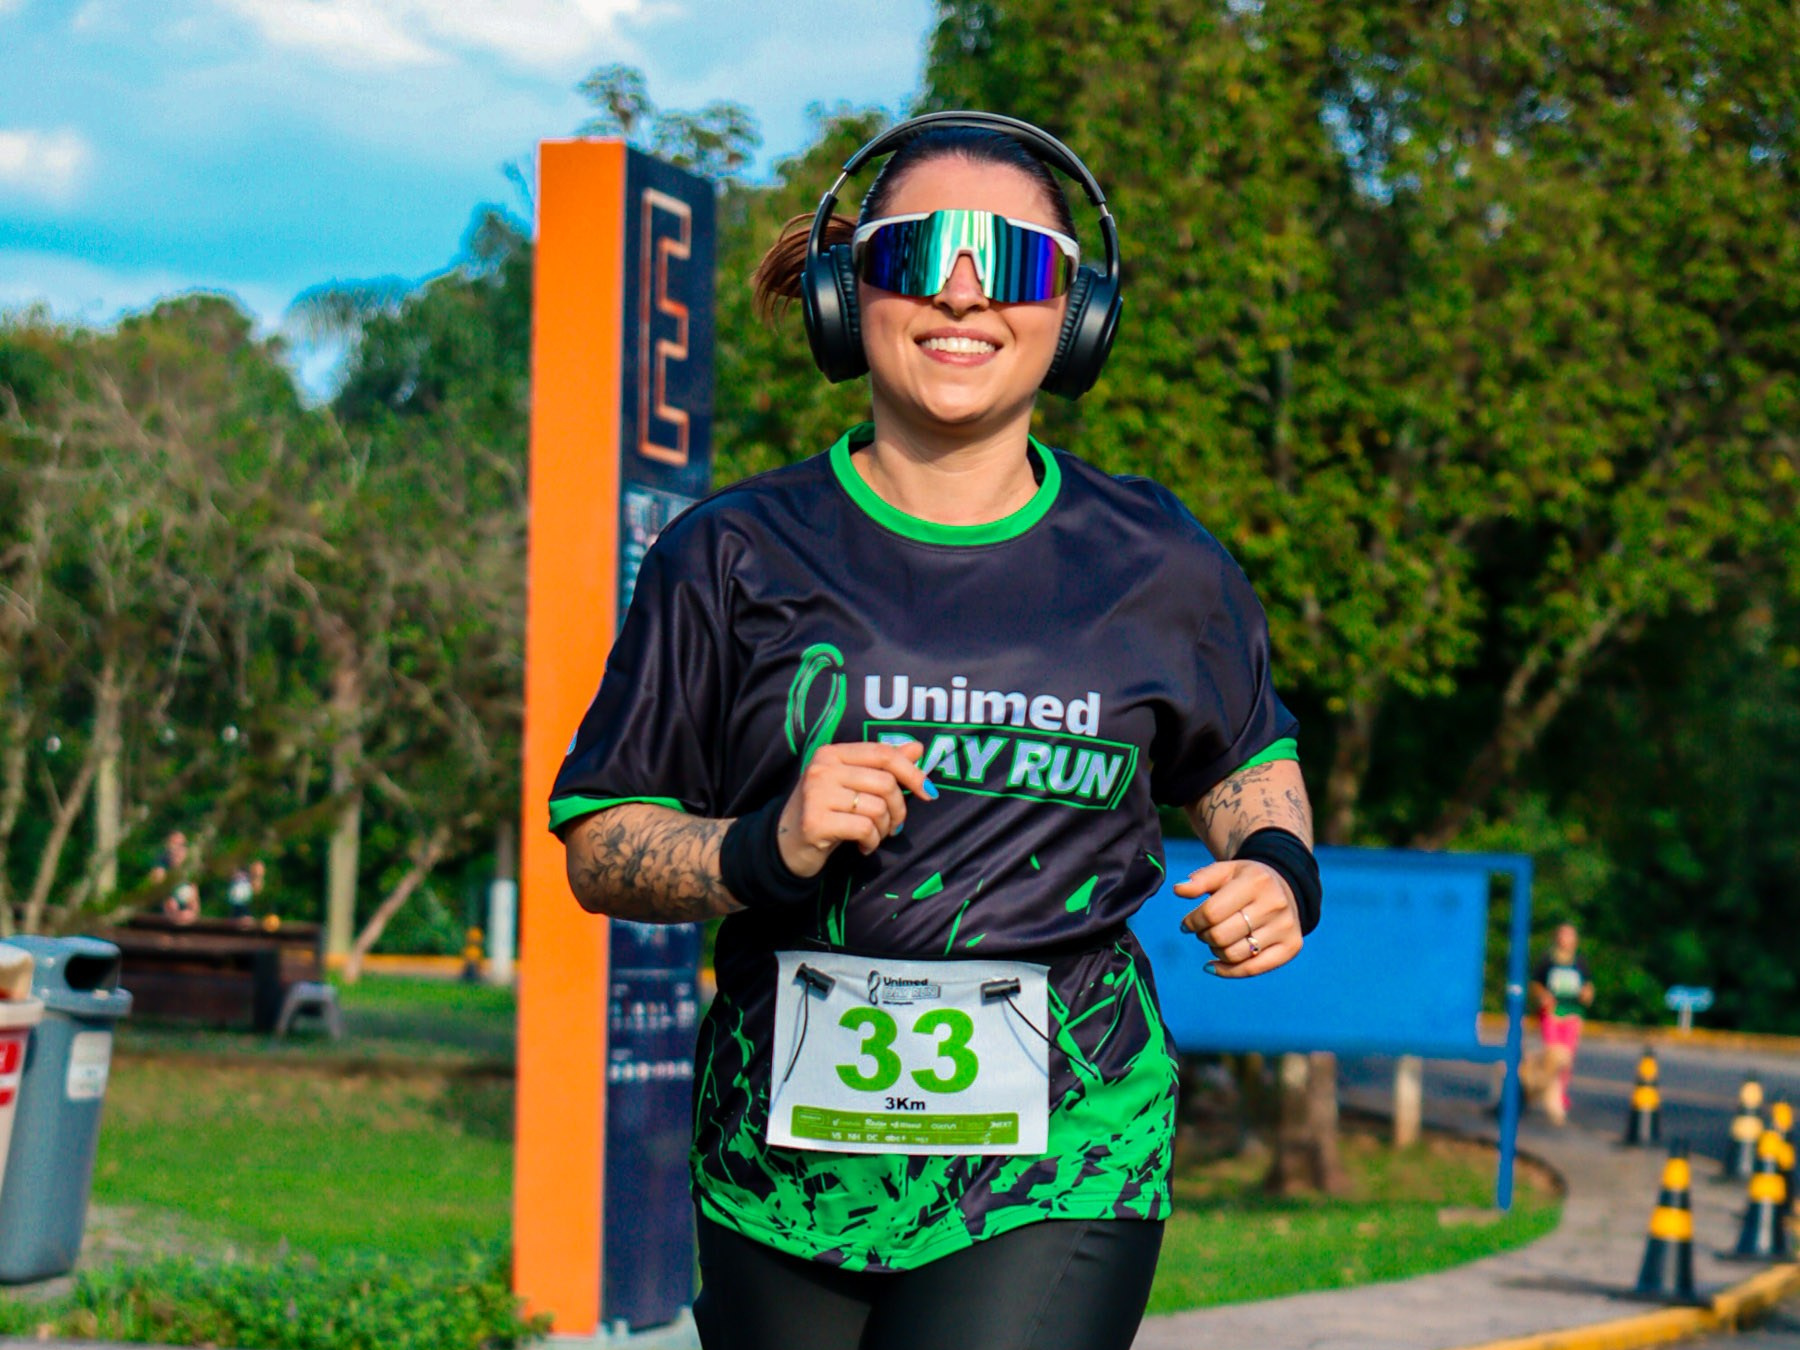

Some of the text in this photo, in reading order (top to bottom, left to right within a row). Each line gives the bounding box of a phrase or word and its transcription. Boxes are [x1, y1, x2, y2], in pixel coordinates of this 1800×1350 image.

[864, 674, 1101, 736] Unimed
[1005, 738, 1125, 800] RUN
[883, 976, 928, 987] Unimed
[835, 1006, 980, 1094] 33
[885, 1097, 926, 1111] 3Km
